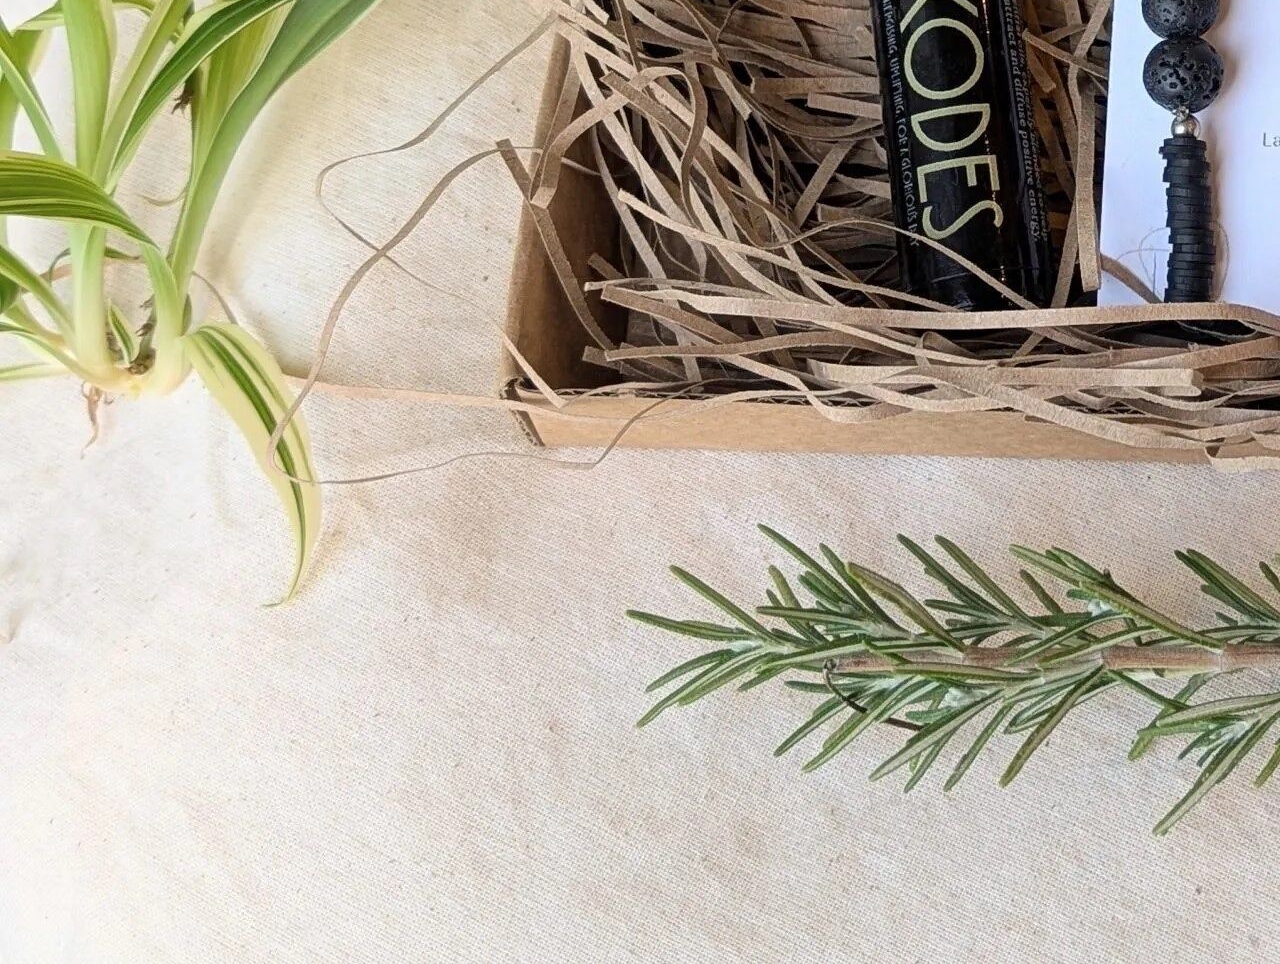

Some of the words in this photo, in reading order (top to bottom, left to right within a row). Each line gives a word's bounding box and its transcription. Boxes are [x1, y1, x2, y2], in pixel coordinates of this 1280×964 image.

[1009, 49, 1021, 75] and
[1012, 78, 1026, 127] diffuse
[1018, 130, 1034, 185] positive
